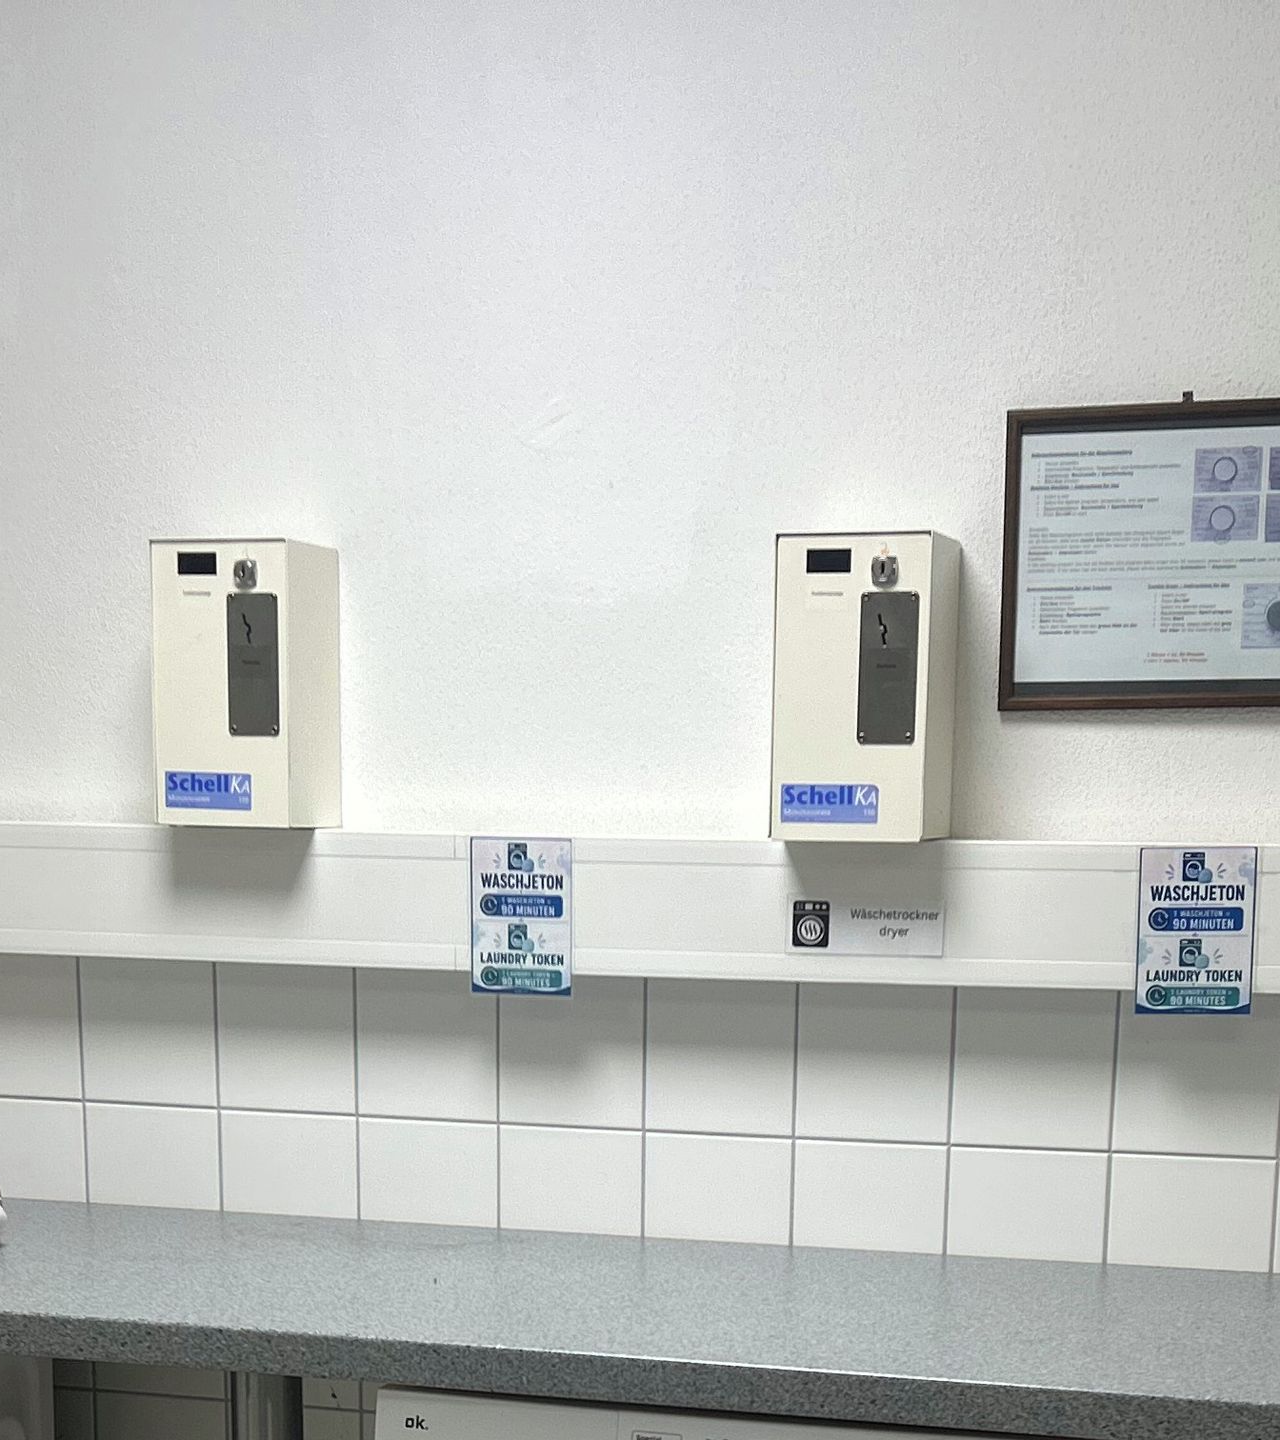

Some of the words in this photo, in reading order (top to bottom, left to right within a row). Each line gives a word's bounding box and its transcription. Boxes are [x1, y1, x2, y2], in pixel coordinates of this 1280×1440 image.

[480, 872, 564, 890] WASCHJETON
[1150, 884, 1246, 902] WASCHJETON
[516, 905, 555, 916] MINUTEN
[850, 908, 940, 921] Wäschetrockner
[1172, 918, 1186, 930] 90
[1190, 918, 1234, 930] MINUTEN
[879, 926, 910, 940] dryer
[480, 952, 527, 964] LAUNDRY
[532, 954, 564, 966] TOKEN
[1146, 970, 1201, 982] LAUNDRY
[1205, 970, 1243, 982] TOKEN
[515, 978, 550, 988] MINUTES
[1170, 996, 1183, 1006] 90
[1184, 996, 1226, 1006] MINUTES
